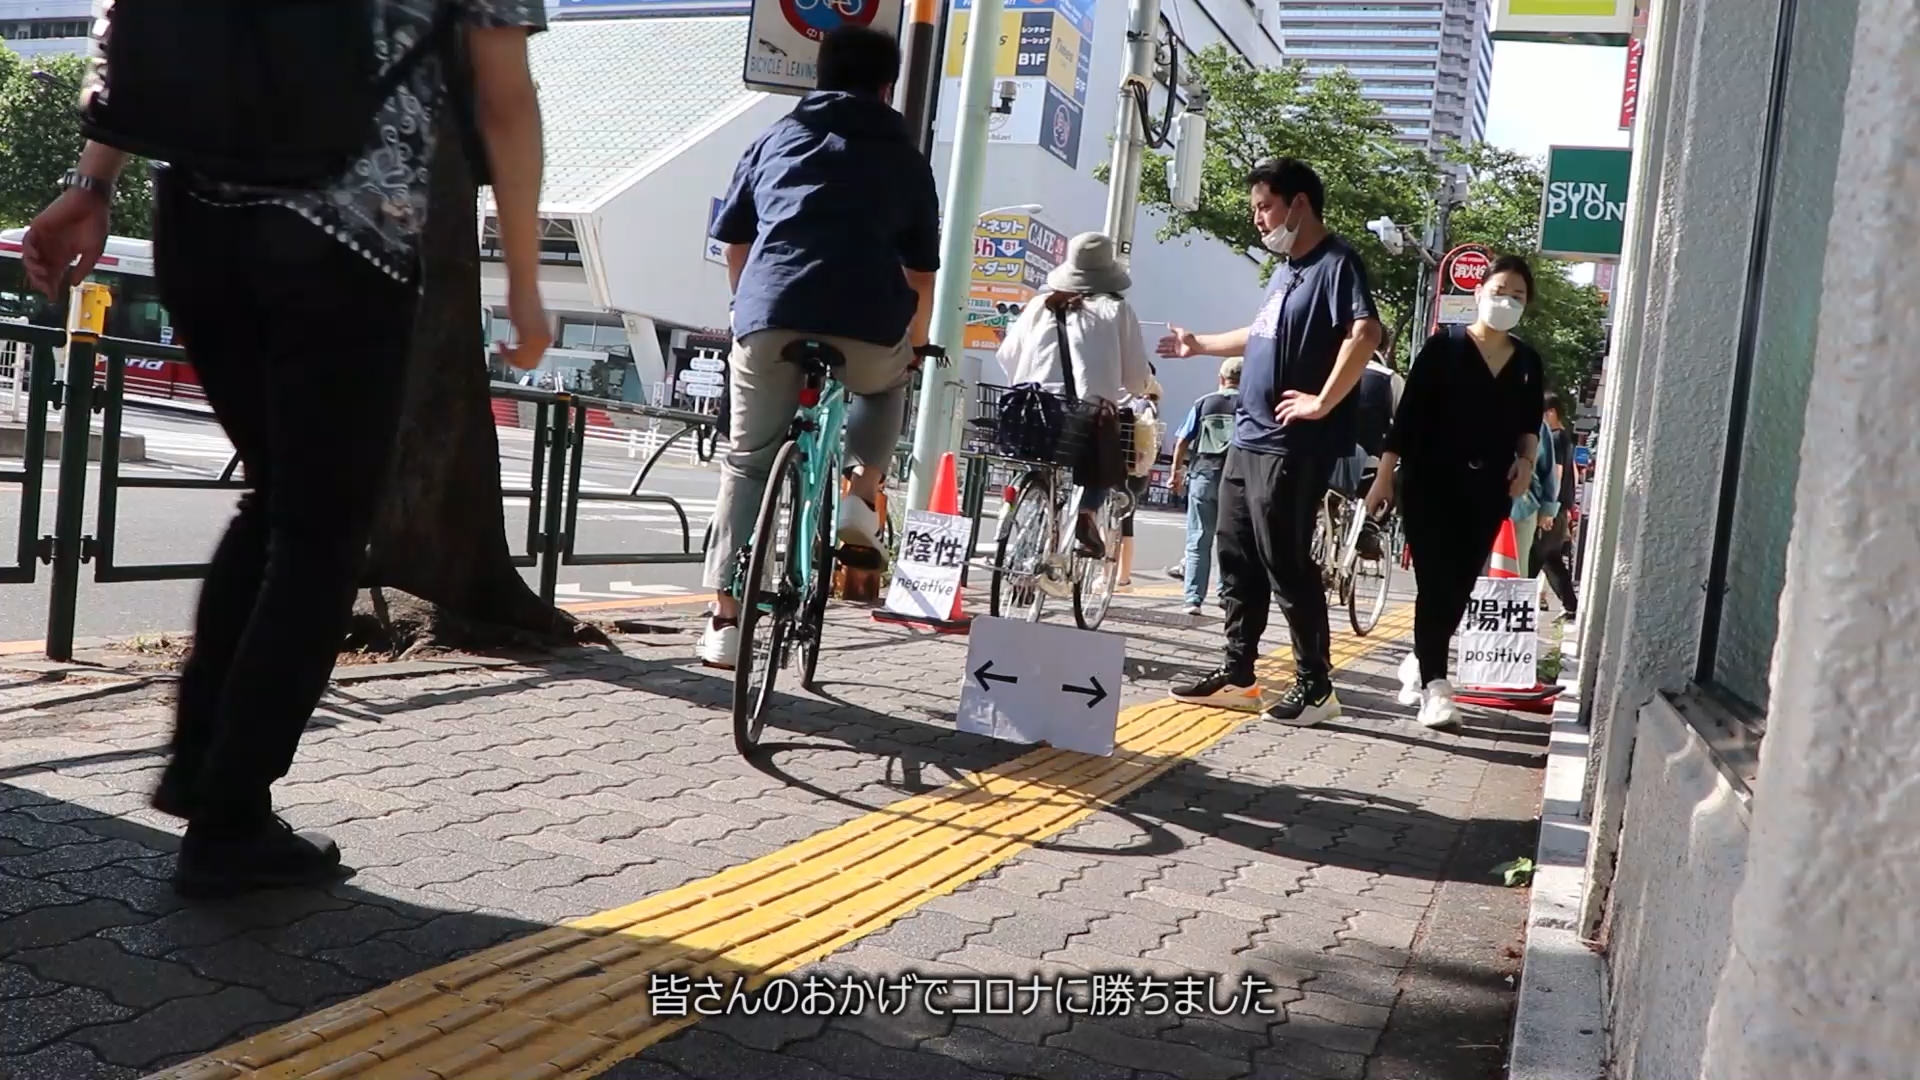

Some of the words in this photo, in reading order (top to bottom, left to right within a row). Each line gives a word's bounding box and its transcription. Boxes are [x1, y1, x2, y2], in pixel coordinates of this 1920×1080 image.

[1021, 26, 1051, 34] レンタカー
[1021, 37, 1050, 45] カーシェア
[751, 56, 781, 75] BICYCLE
[1018, 53, 1046, 66] B1F
[1550, 182, 1607, 202] SUN
[1547, 196, 1626, 221] PYON
[1005, 242, 1016, 251] B1
[1028, 222, 1056, 254] CAFE
[904, 530, 962, 568] 陰性
[897, 577, 953, 596] negative
[1465, 599, 1535, 632] 陽性
[1464, 647, 1533, 664] positive
